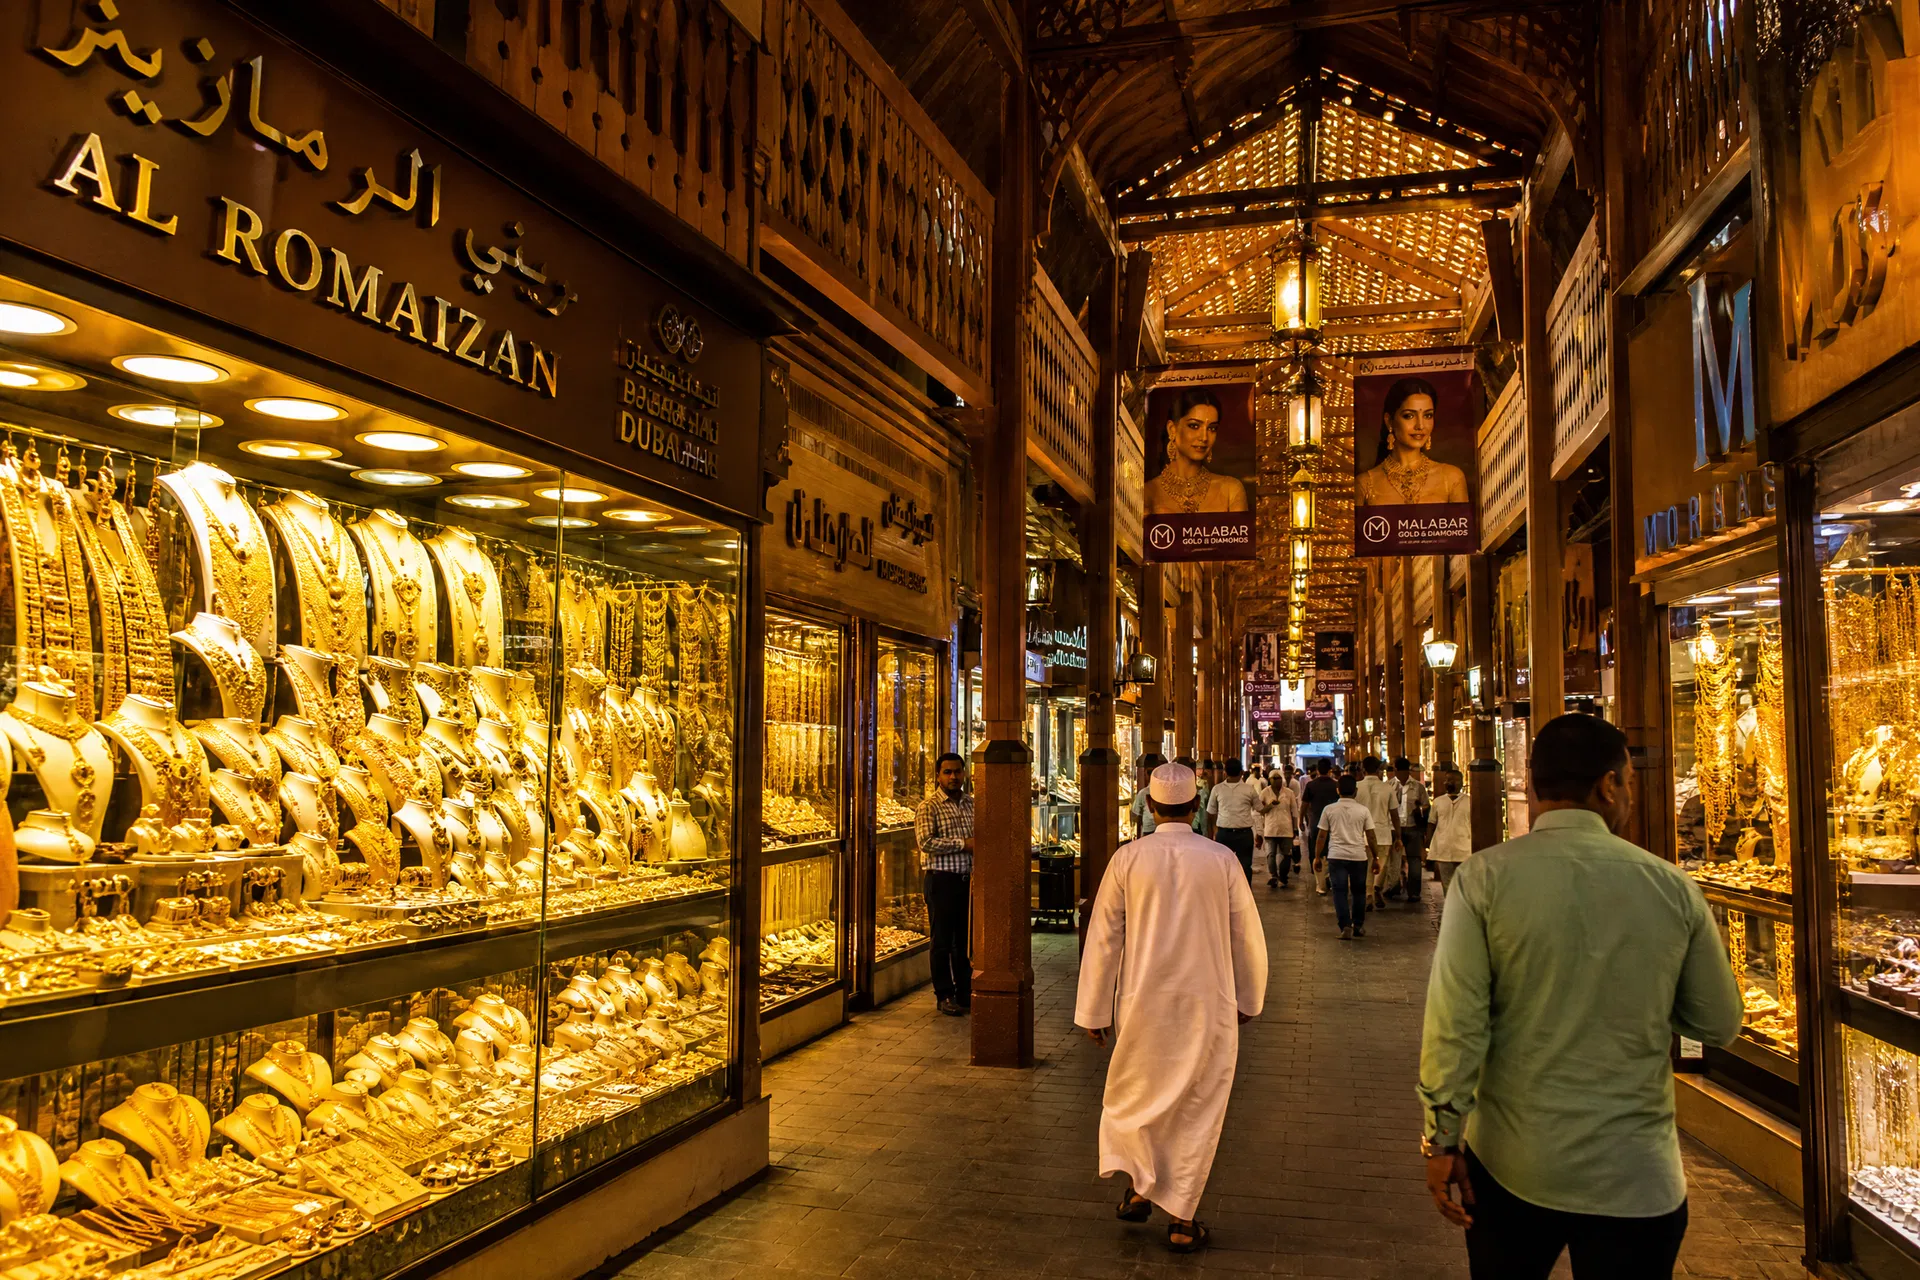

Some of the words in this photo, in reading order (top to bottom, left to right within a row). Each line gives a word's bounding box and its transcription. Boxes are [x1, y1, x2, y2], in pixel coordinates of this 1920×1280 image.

[54, 132, 178, 236] AL
[215, 195, 561, 399] ROMAIZAN
[1687, 272, 1756, 471] M
[1397, 517, 1469, 530] MALABAR
[1182, 525, 1249, 537] MALABAR
[1397, 530, 1420, 538] GOLD
